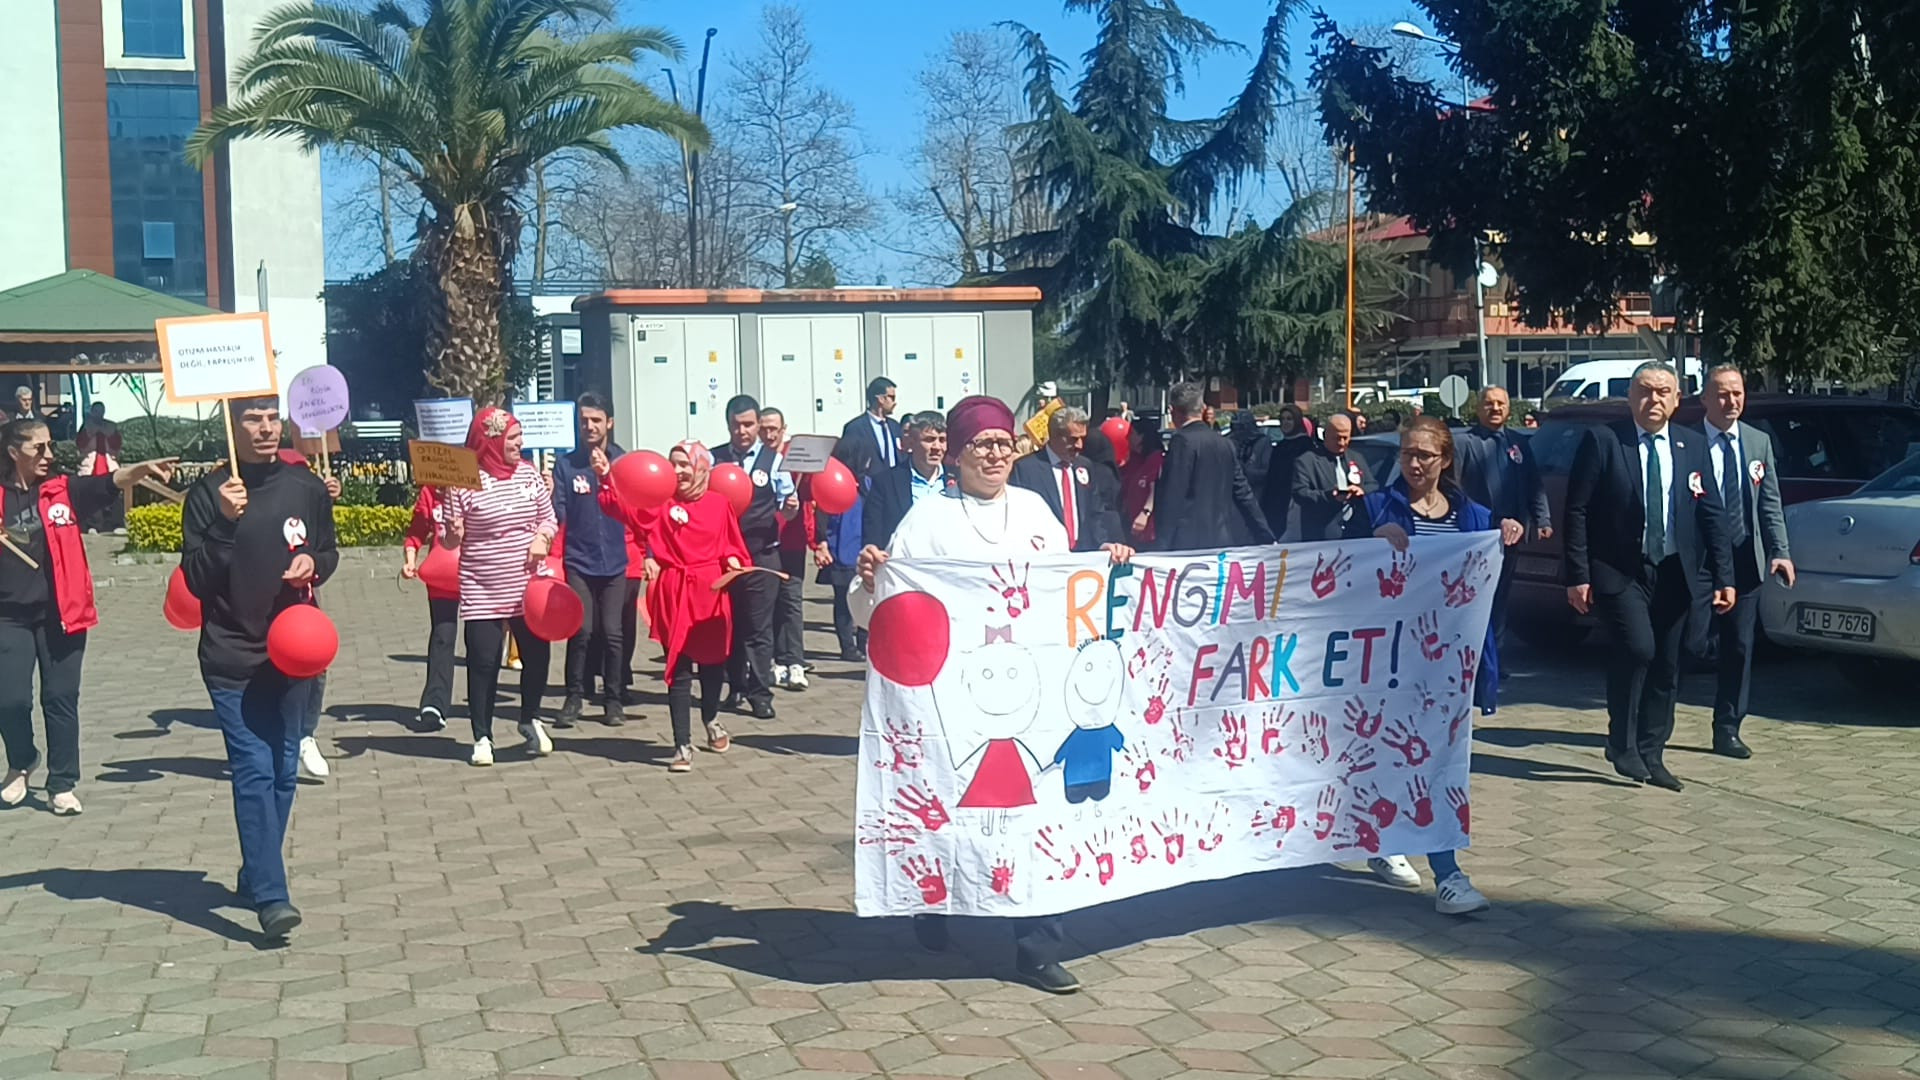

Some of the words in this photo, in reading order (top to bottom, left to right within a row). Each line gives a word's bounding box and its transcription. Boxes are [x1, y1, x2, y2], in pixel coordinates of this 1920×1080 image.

[1066, 549, 1289, 649] RENGİMİ
[1803, 611, 1817, 628] 41
[1821, 612, 1832, 630] B
[1837, 613, 1870, 633] 7676
[1187, 632, 1300, 707] FARK
[1322, 619, 1403, 690] ET!
